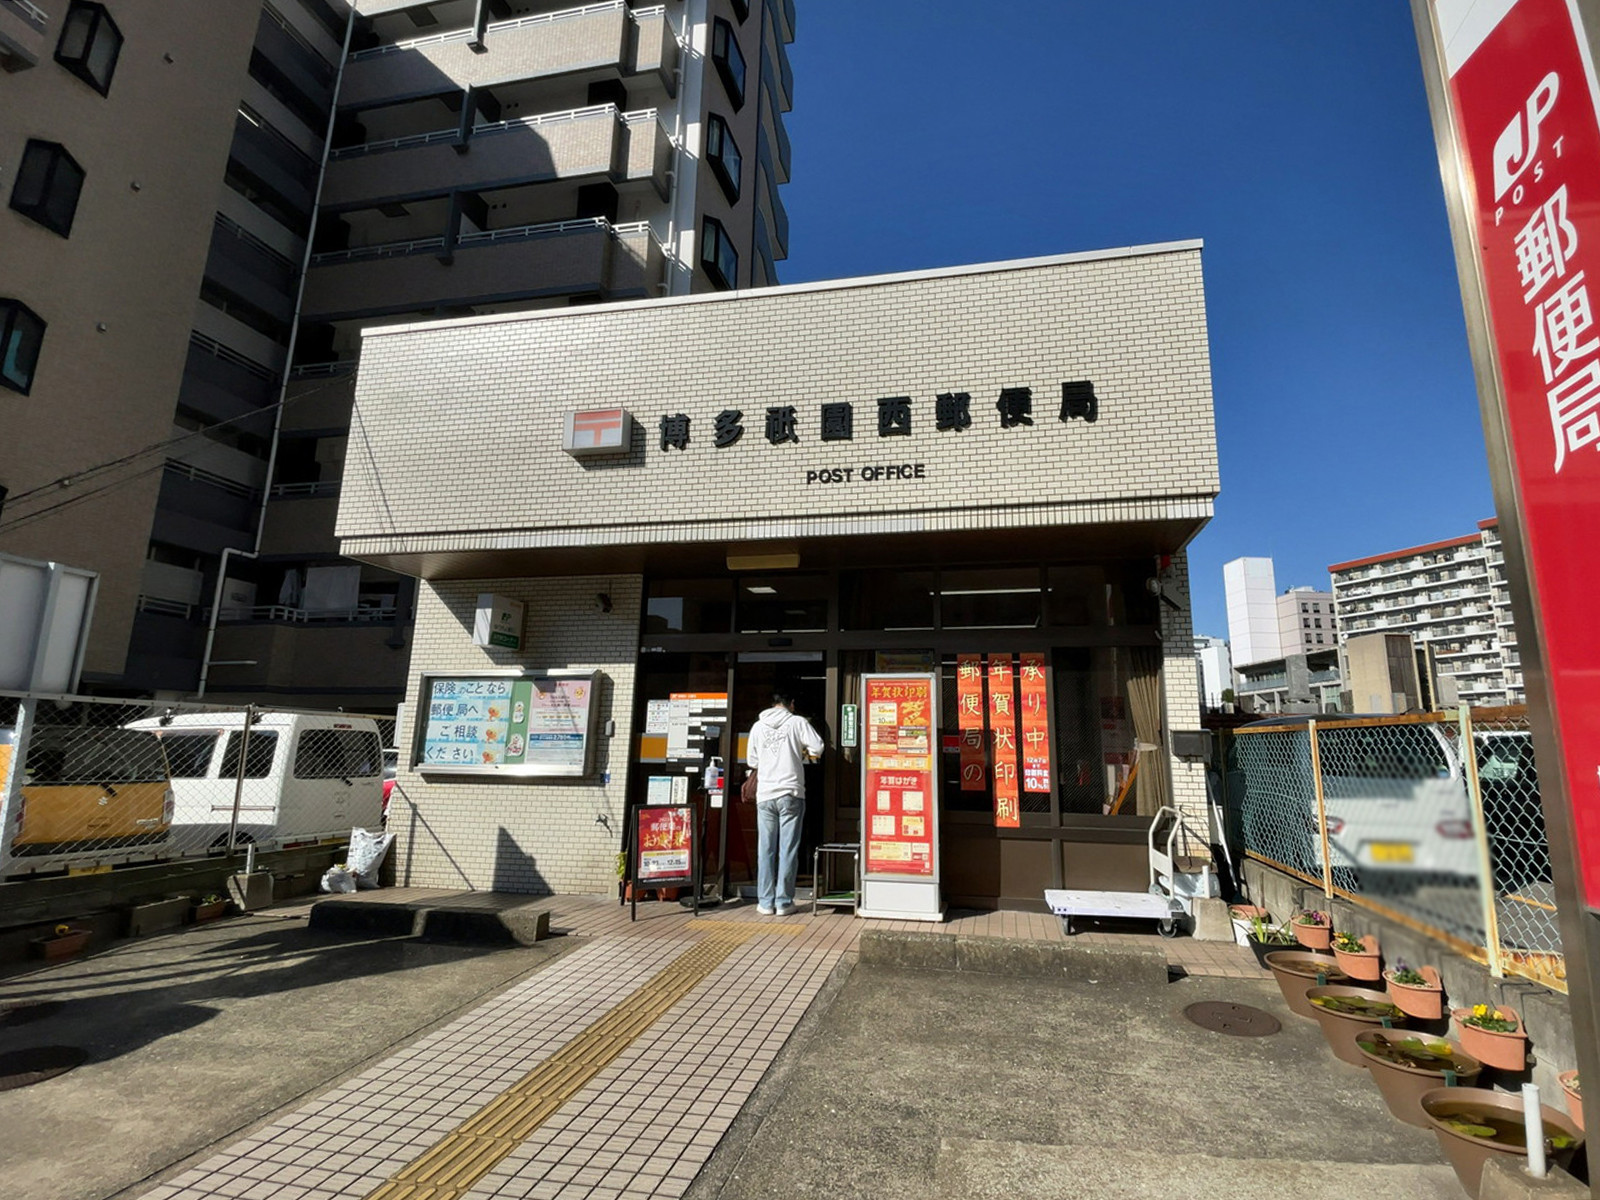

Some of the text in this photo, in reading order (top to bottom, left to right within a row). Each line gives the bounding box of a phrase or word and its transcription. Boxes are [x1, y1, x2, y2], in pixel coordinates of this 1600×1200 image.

[1496, 135, 1563, 226] POST
[1513, 183, 1600, 475] 郵便局
[807, 464, 926, 485] POST OFFICE
[431, 703, 479, 717] 郵便局へ
[440, 725, 477, 739] ご相談
[960, 659, 983, 781] 郵便局の
[990, 659, 1018, 821] 年賀状印刷
[1022, 659, 1046, 750] 承り中
[427, 746, 473, 760] ください
